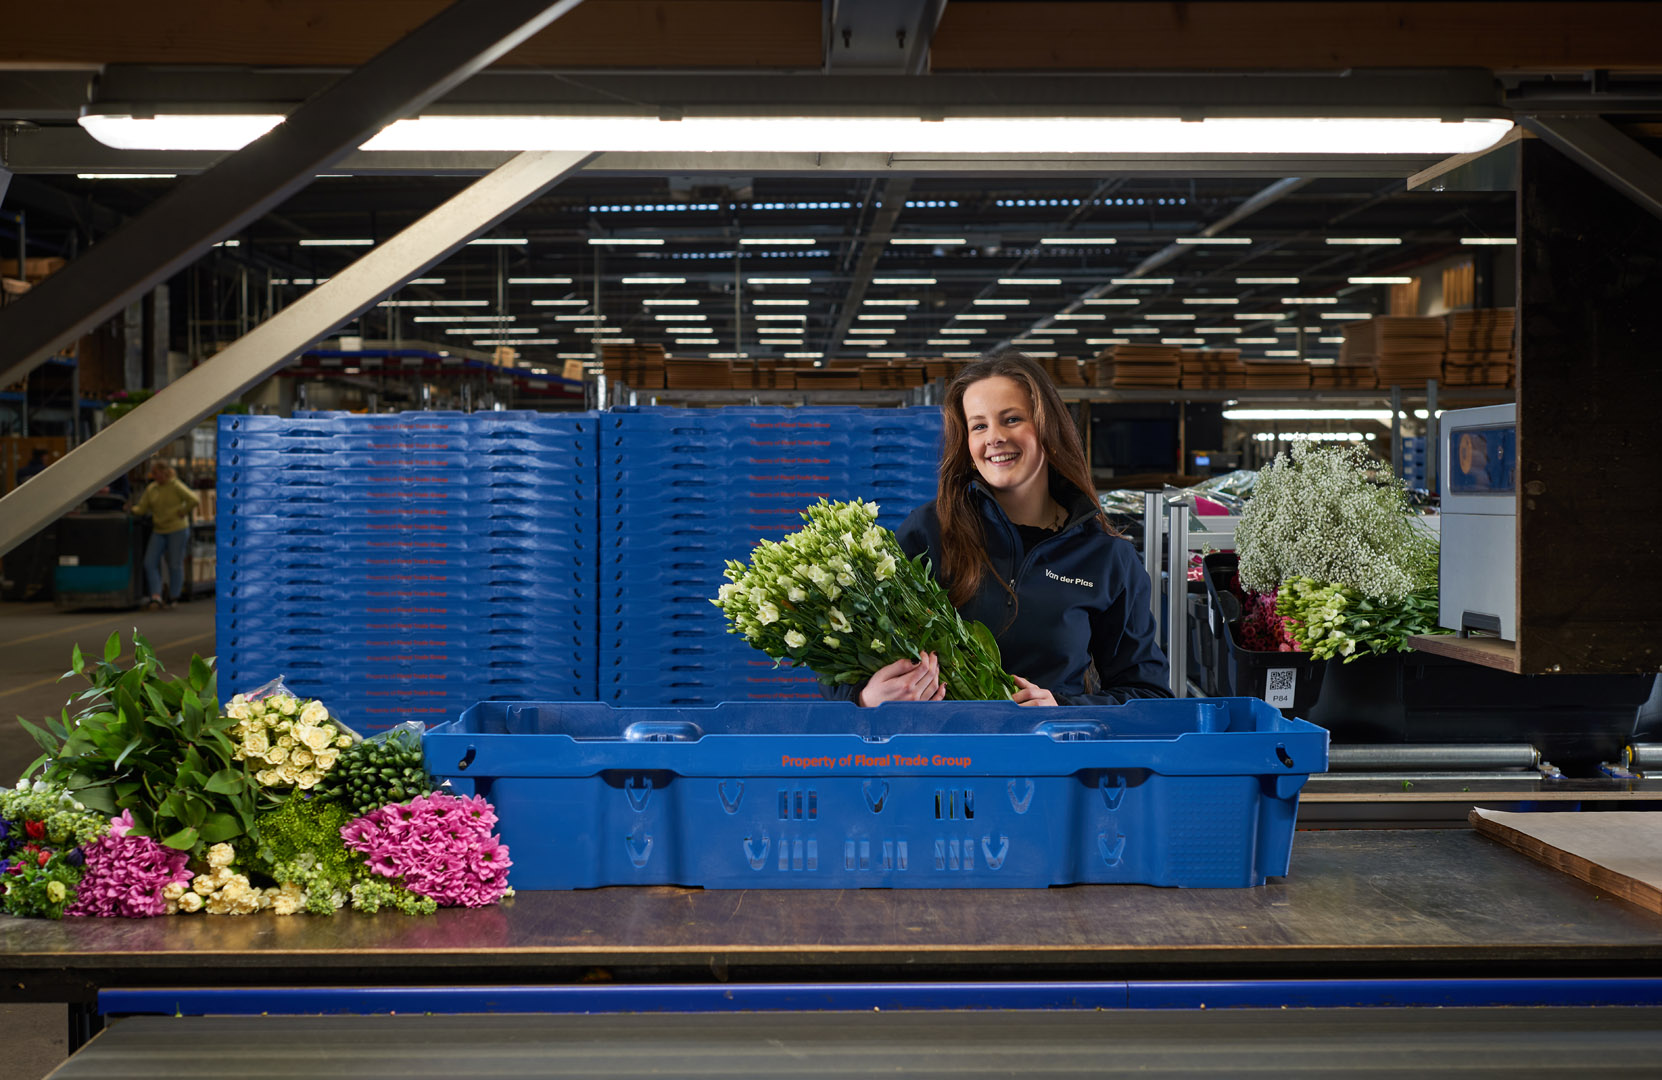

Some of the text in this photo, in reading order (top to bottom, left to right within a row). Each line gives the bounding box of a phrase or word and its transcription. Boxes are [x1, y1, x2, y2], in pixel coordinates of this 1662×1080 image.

[1045, 568, 1093, 587] Van der Plas
[782, 754, 971, 769] Property of Floral Trade Group
